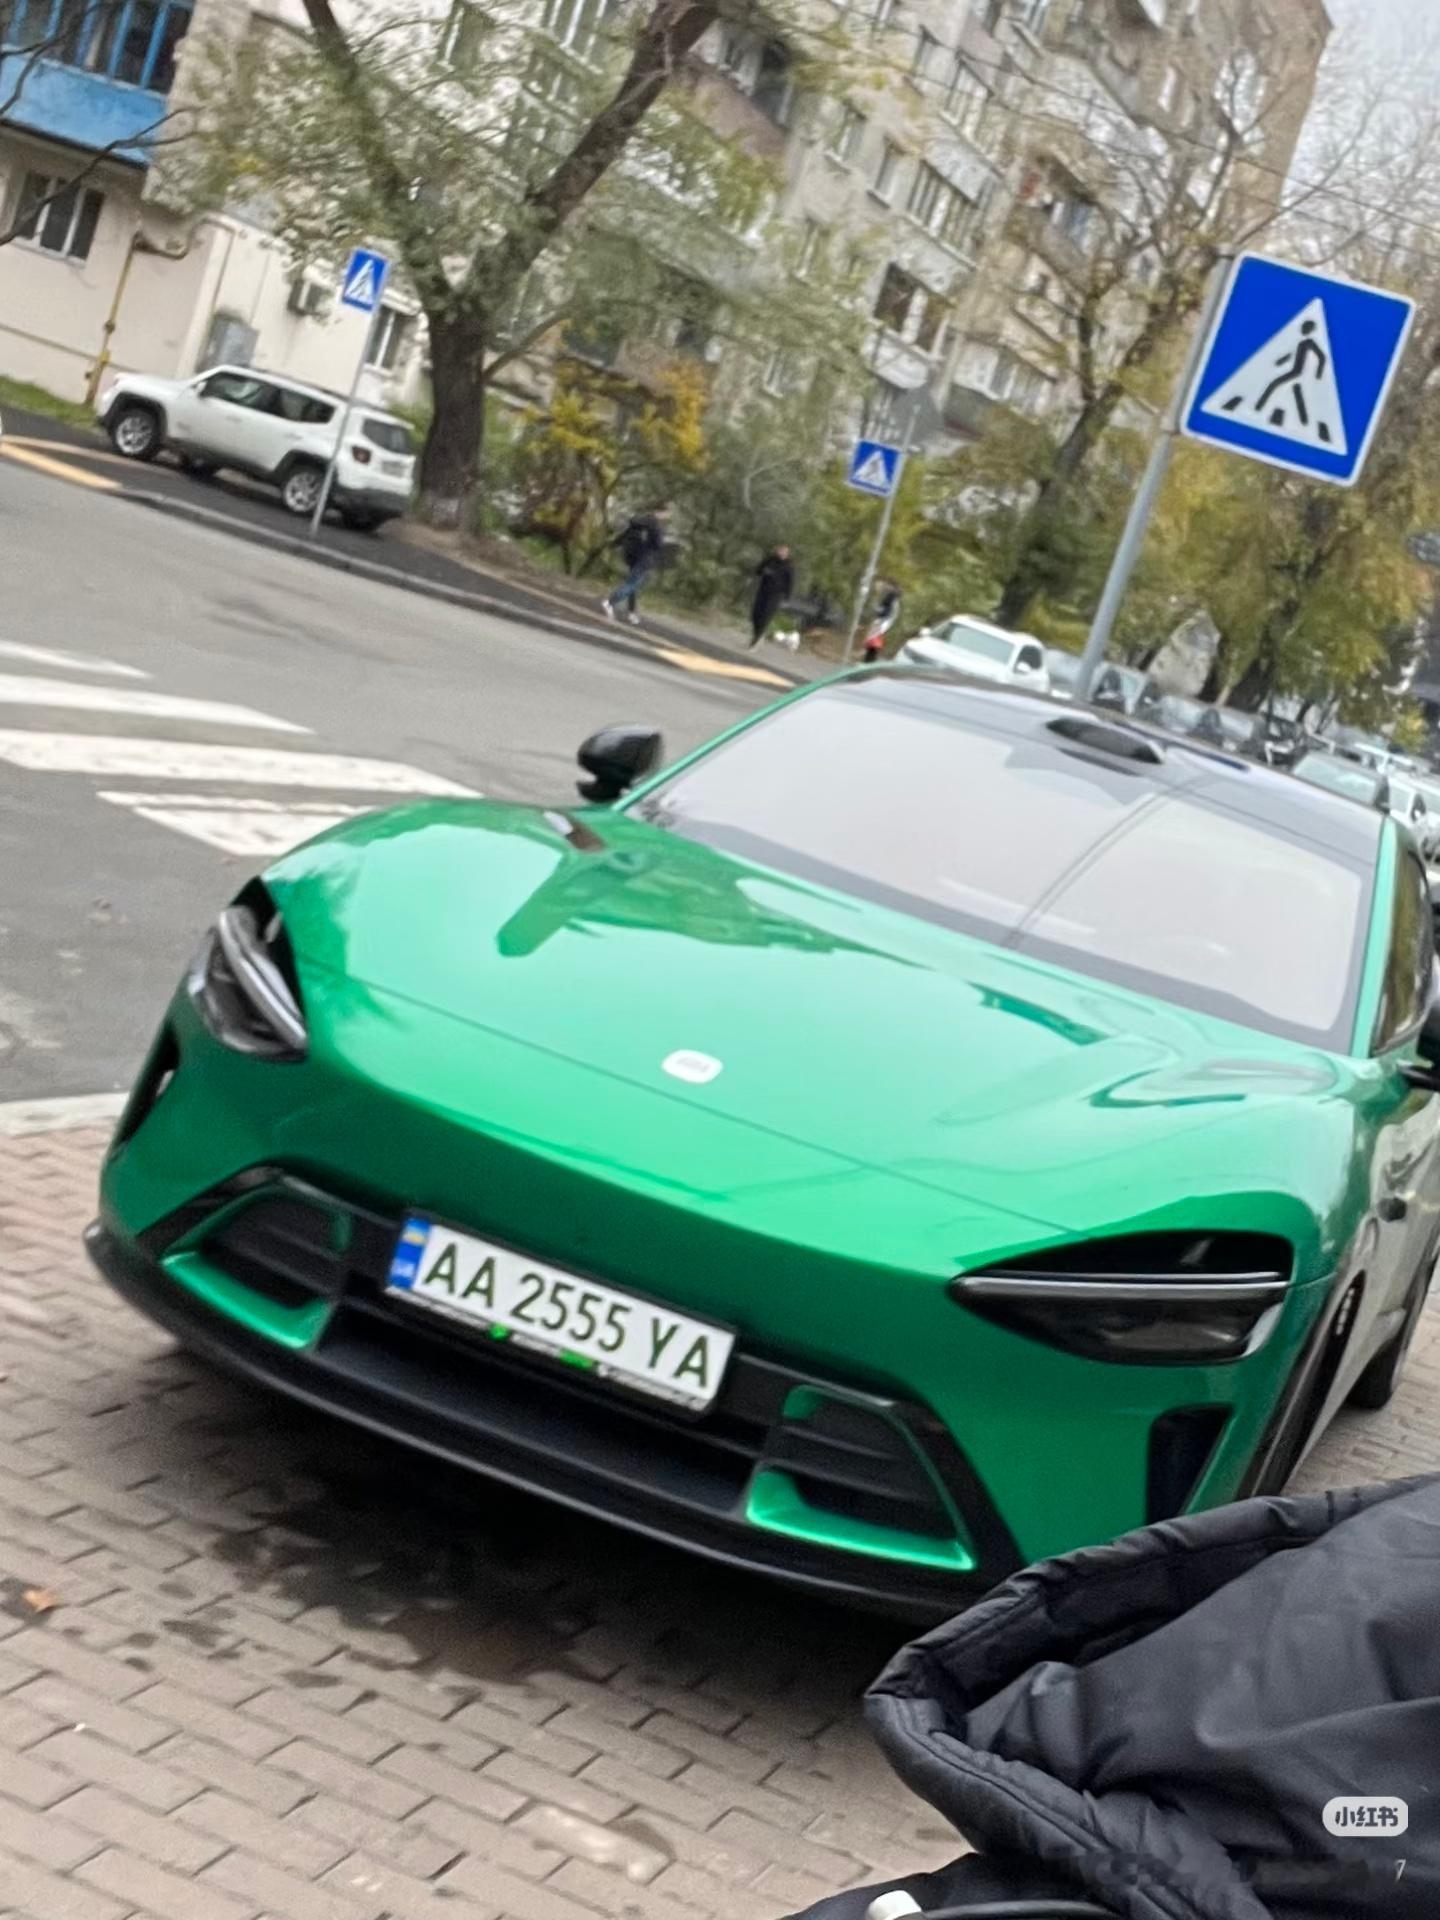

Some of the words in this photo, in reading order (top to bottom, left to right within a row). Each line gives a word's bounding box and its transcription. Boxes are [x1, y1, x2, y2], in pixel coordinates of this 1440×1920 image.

[424, 1242, 497, 1309] AA
[509, 1272, 633, 1353] 2555
[647, 1317, 708, 1389] YA
